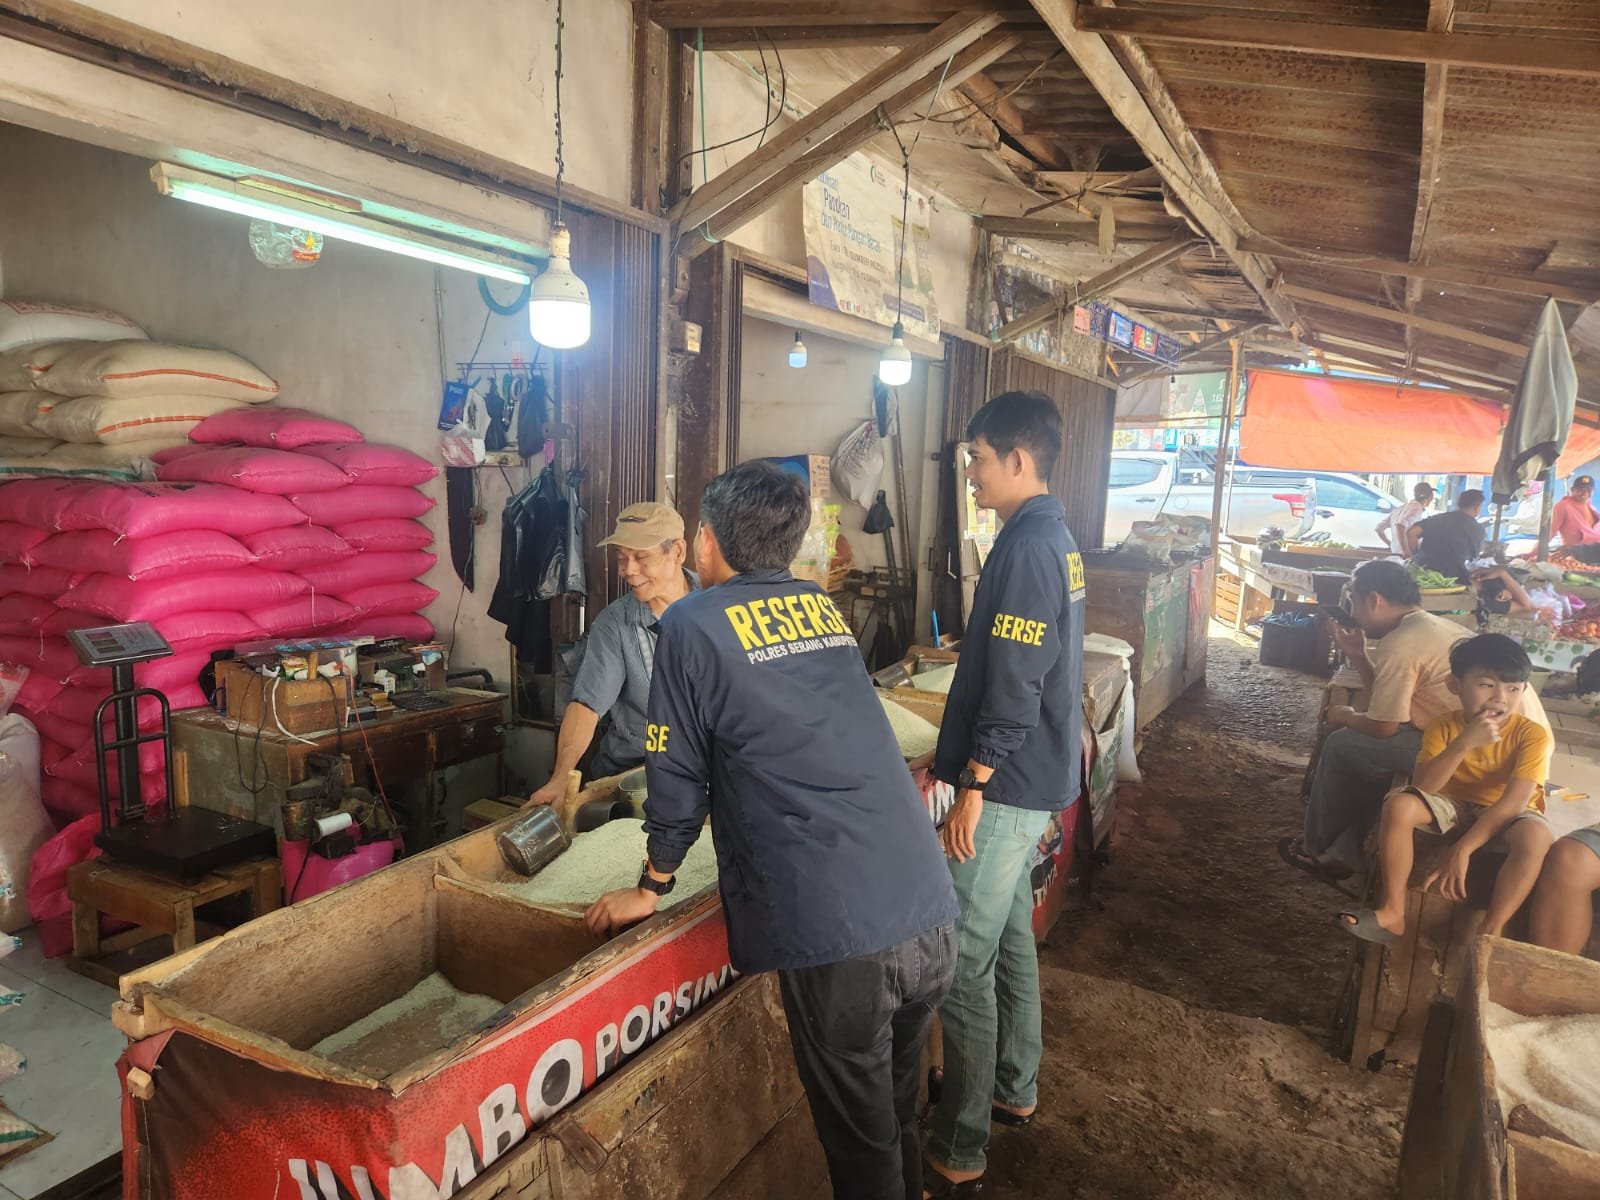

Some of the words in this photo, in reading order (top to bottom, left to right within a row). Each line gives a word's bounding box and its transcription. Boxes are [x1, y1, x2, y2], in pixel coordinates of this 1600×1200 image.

[724, 593, 853, 651] RESERSE
[992, 613, 1047, 646] SERSE
[747, 643, 789, 665] POLRES
[788, 638, 825, 655] SERANG
